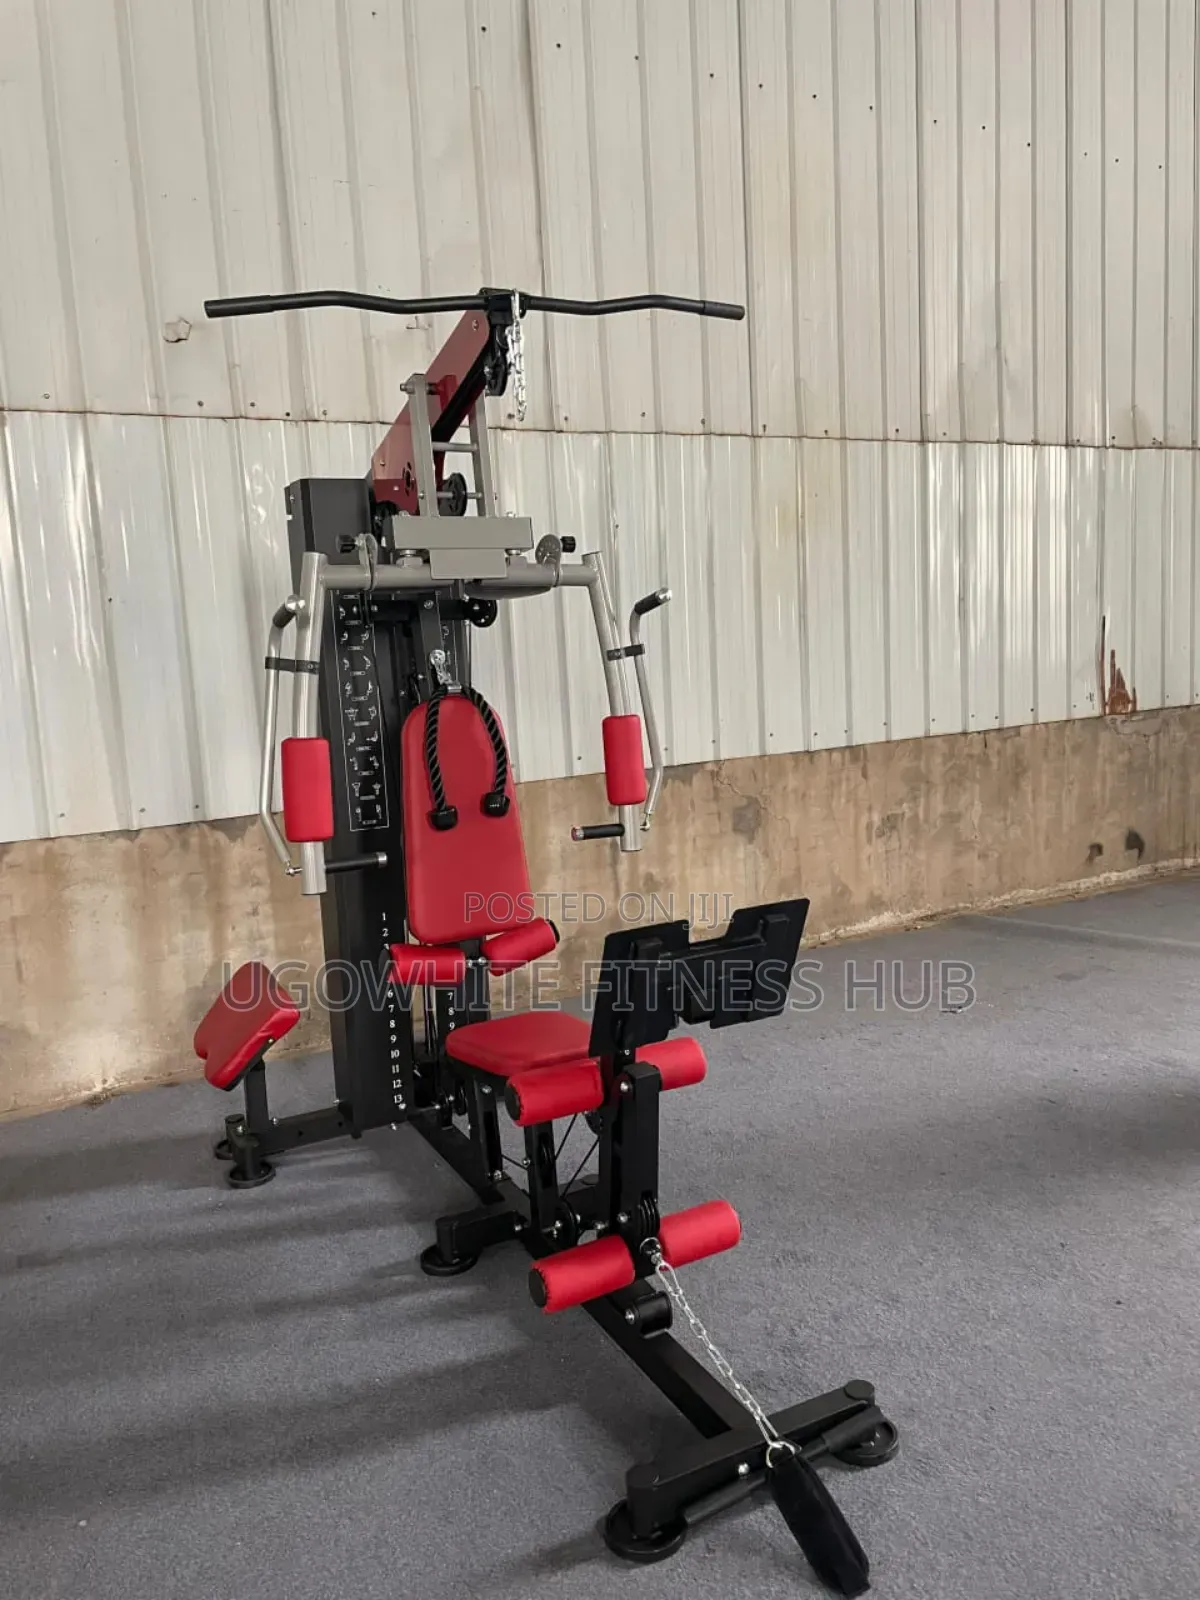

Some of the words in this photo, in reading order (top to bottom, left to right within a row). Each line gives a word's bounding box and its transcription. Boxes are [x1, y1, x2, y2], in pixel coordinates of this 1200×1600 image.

[382, 927, 389, 937] 2
[387, 989, 394, 999] 6
[388, 1004, 395, 1013] 7
[389, 1019, 396, 1029] 8
[390, 1034, 397, 1044] 9
[390, 1049, 400, 1060] 10
[391, 1064, 400, 1074] 11
[392, 1079, 402, 1089] 12
[393, 1094, 403, 1104] 13
